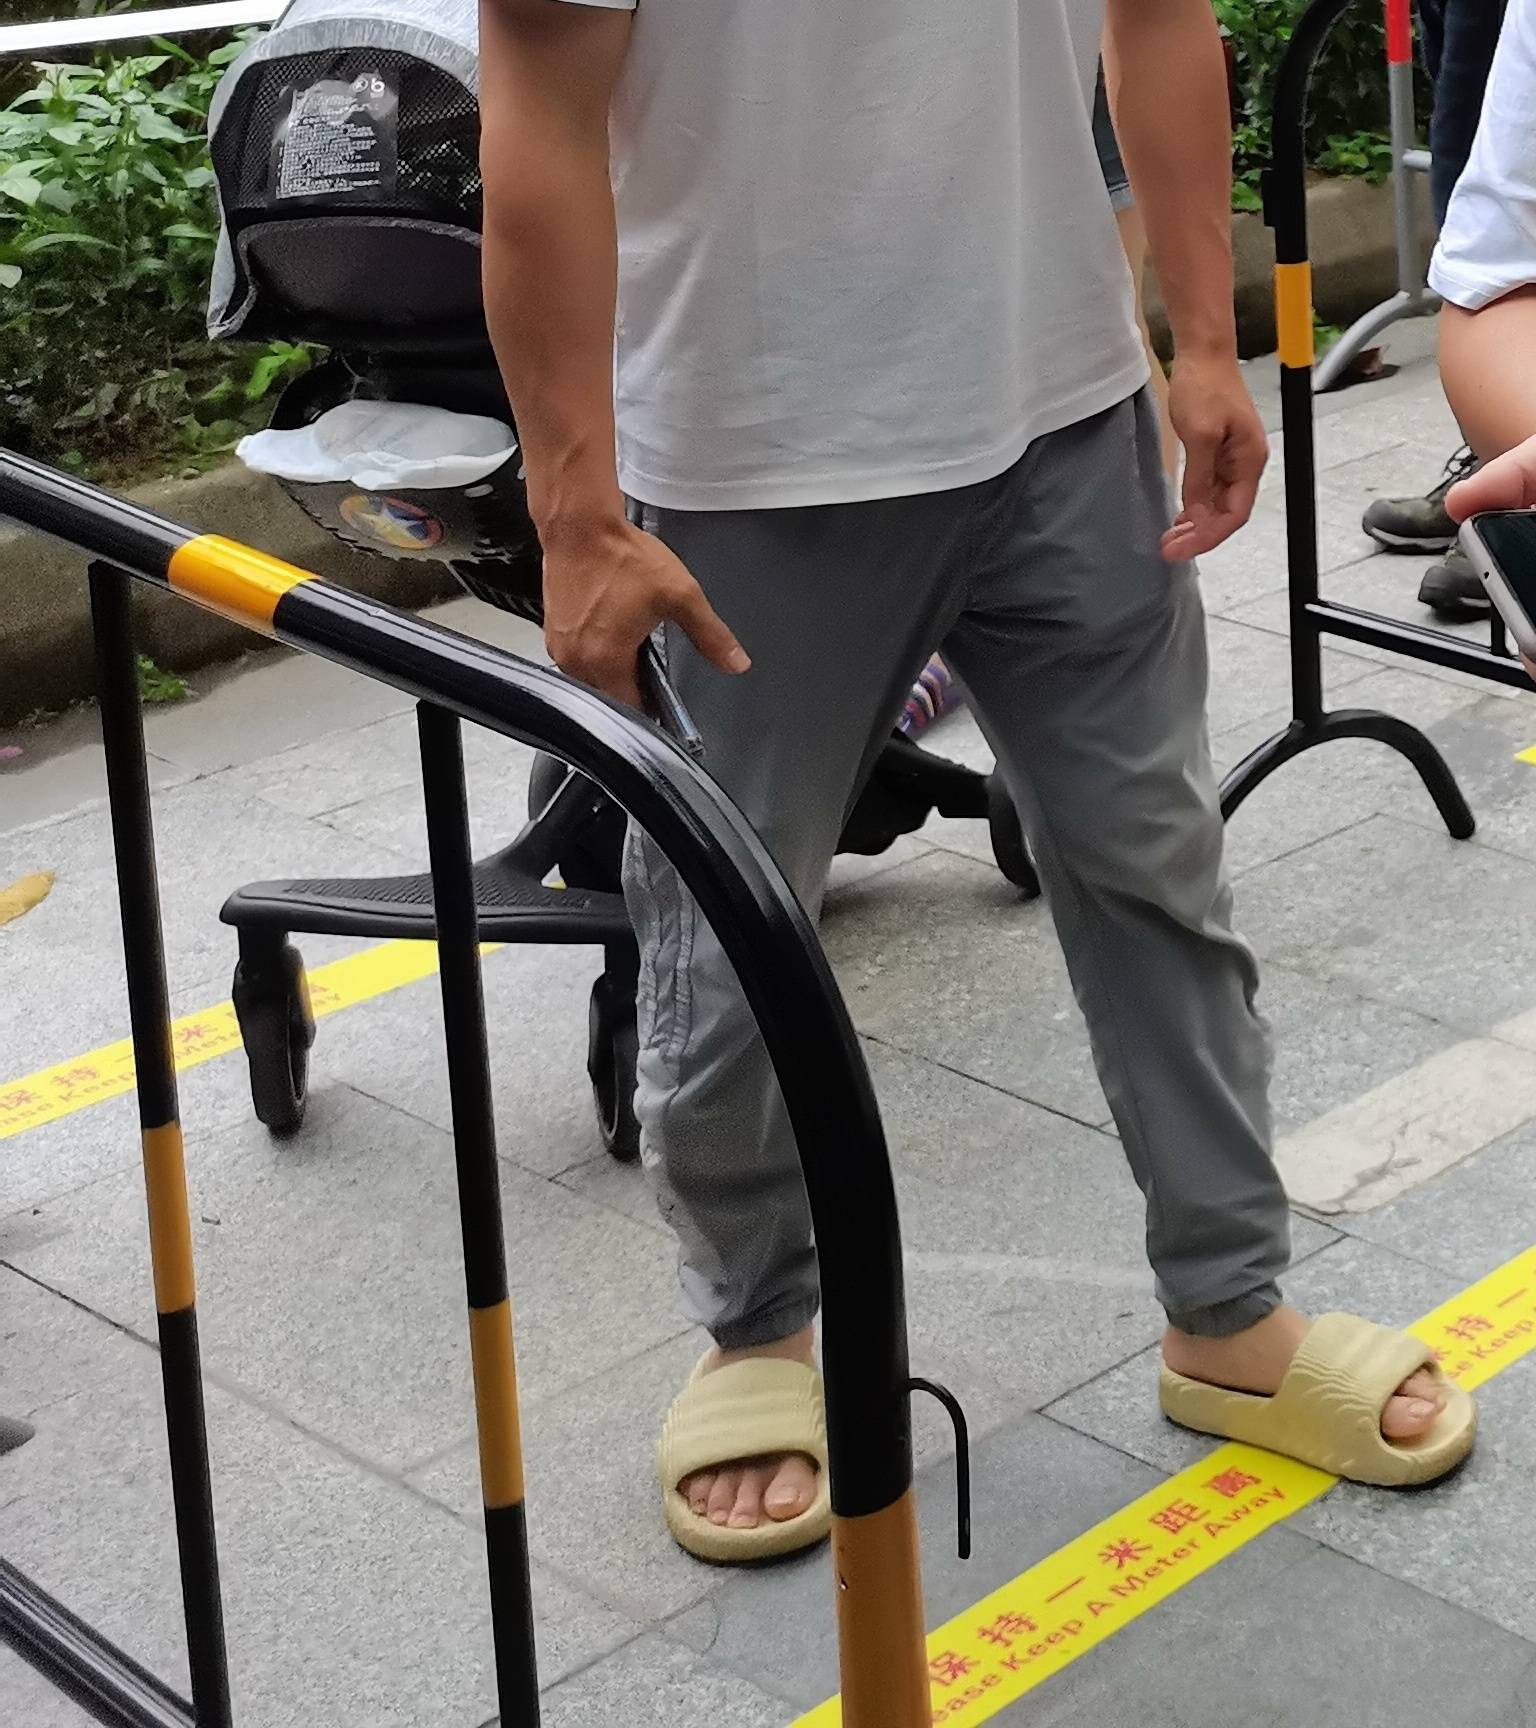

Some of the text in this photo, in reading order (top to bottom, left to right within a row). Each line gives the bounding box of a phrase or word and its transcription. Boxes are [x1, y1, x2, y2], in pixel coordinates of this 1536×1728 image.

[1000, 1621, 1087, 1672] Keep
[1086, 1598, 1115, 1618] A
[1110, 1538, 1202, 1598] Meter
[1204, 1485, 1287, 1539] Away
